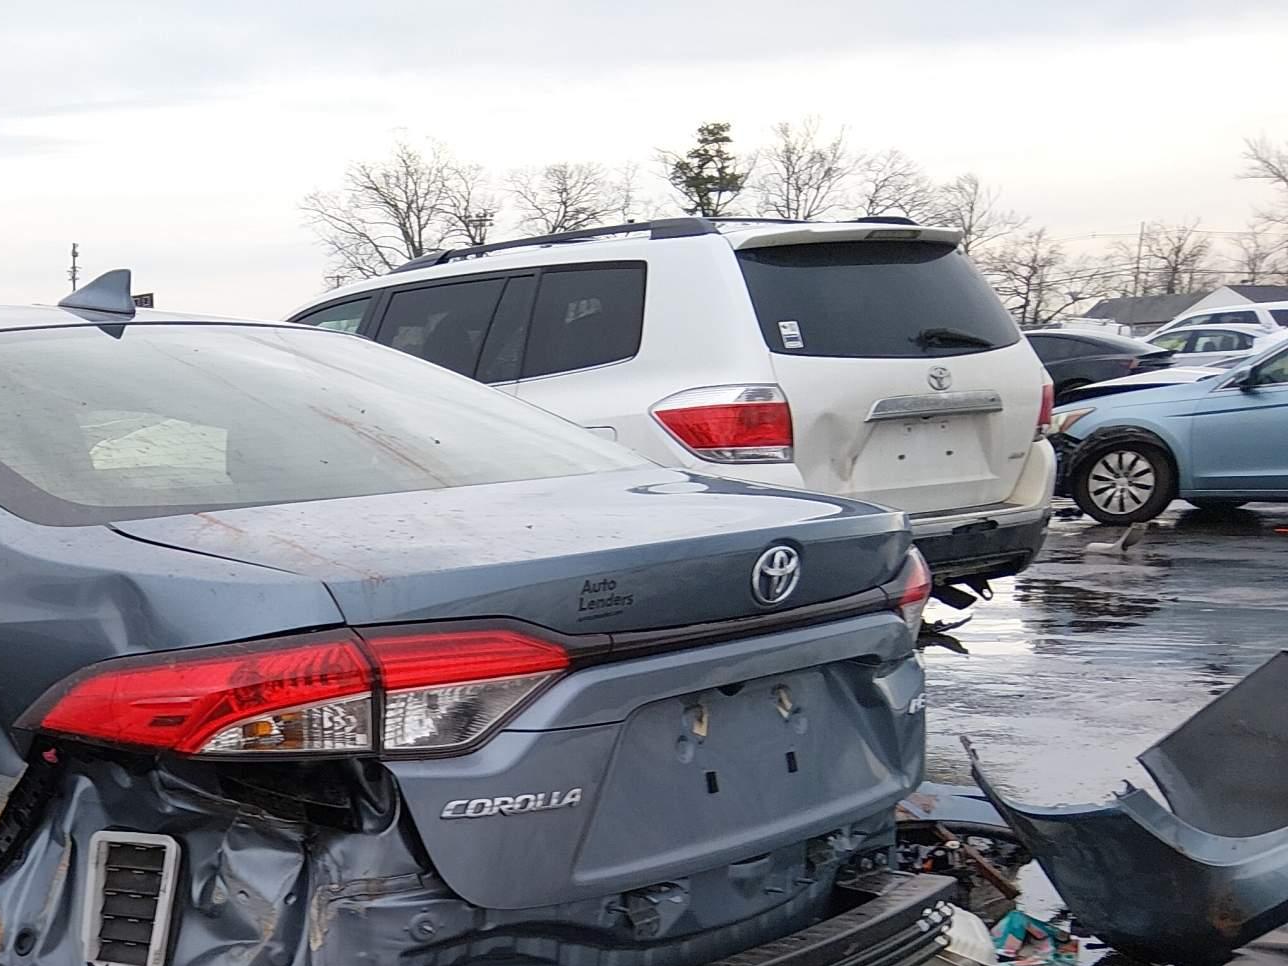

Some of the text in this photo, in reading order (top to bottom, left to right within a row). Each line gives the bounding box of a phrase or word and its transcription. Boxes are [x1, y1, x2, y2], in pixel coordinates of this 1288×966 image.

[582, 578, 618, 595] Auto
[578, 591, 634, 612] Lenders
[440, 787, 583, 820] COROLLA
